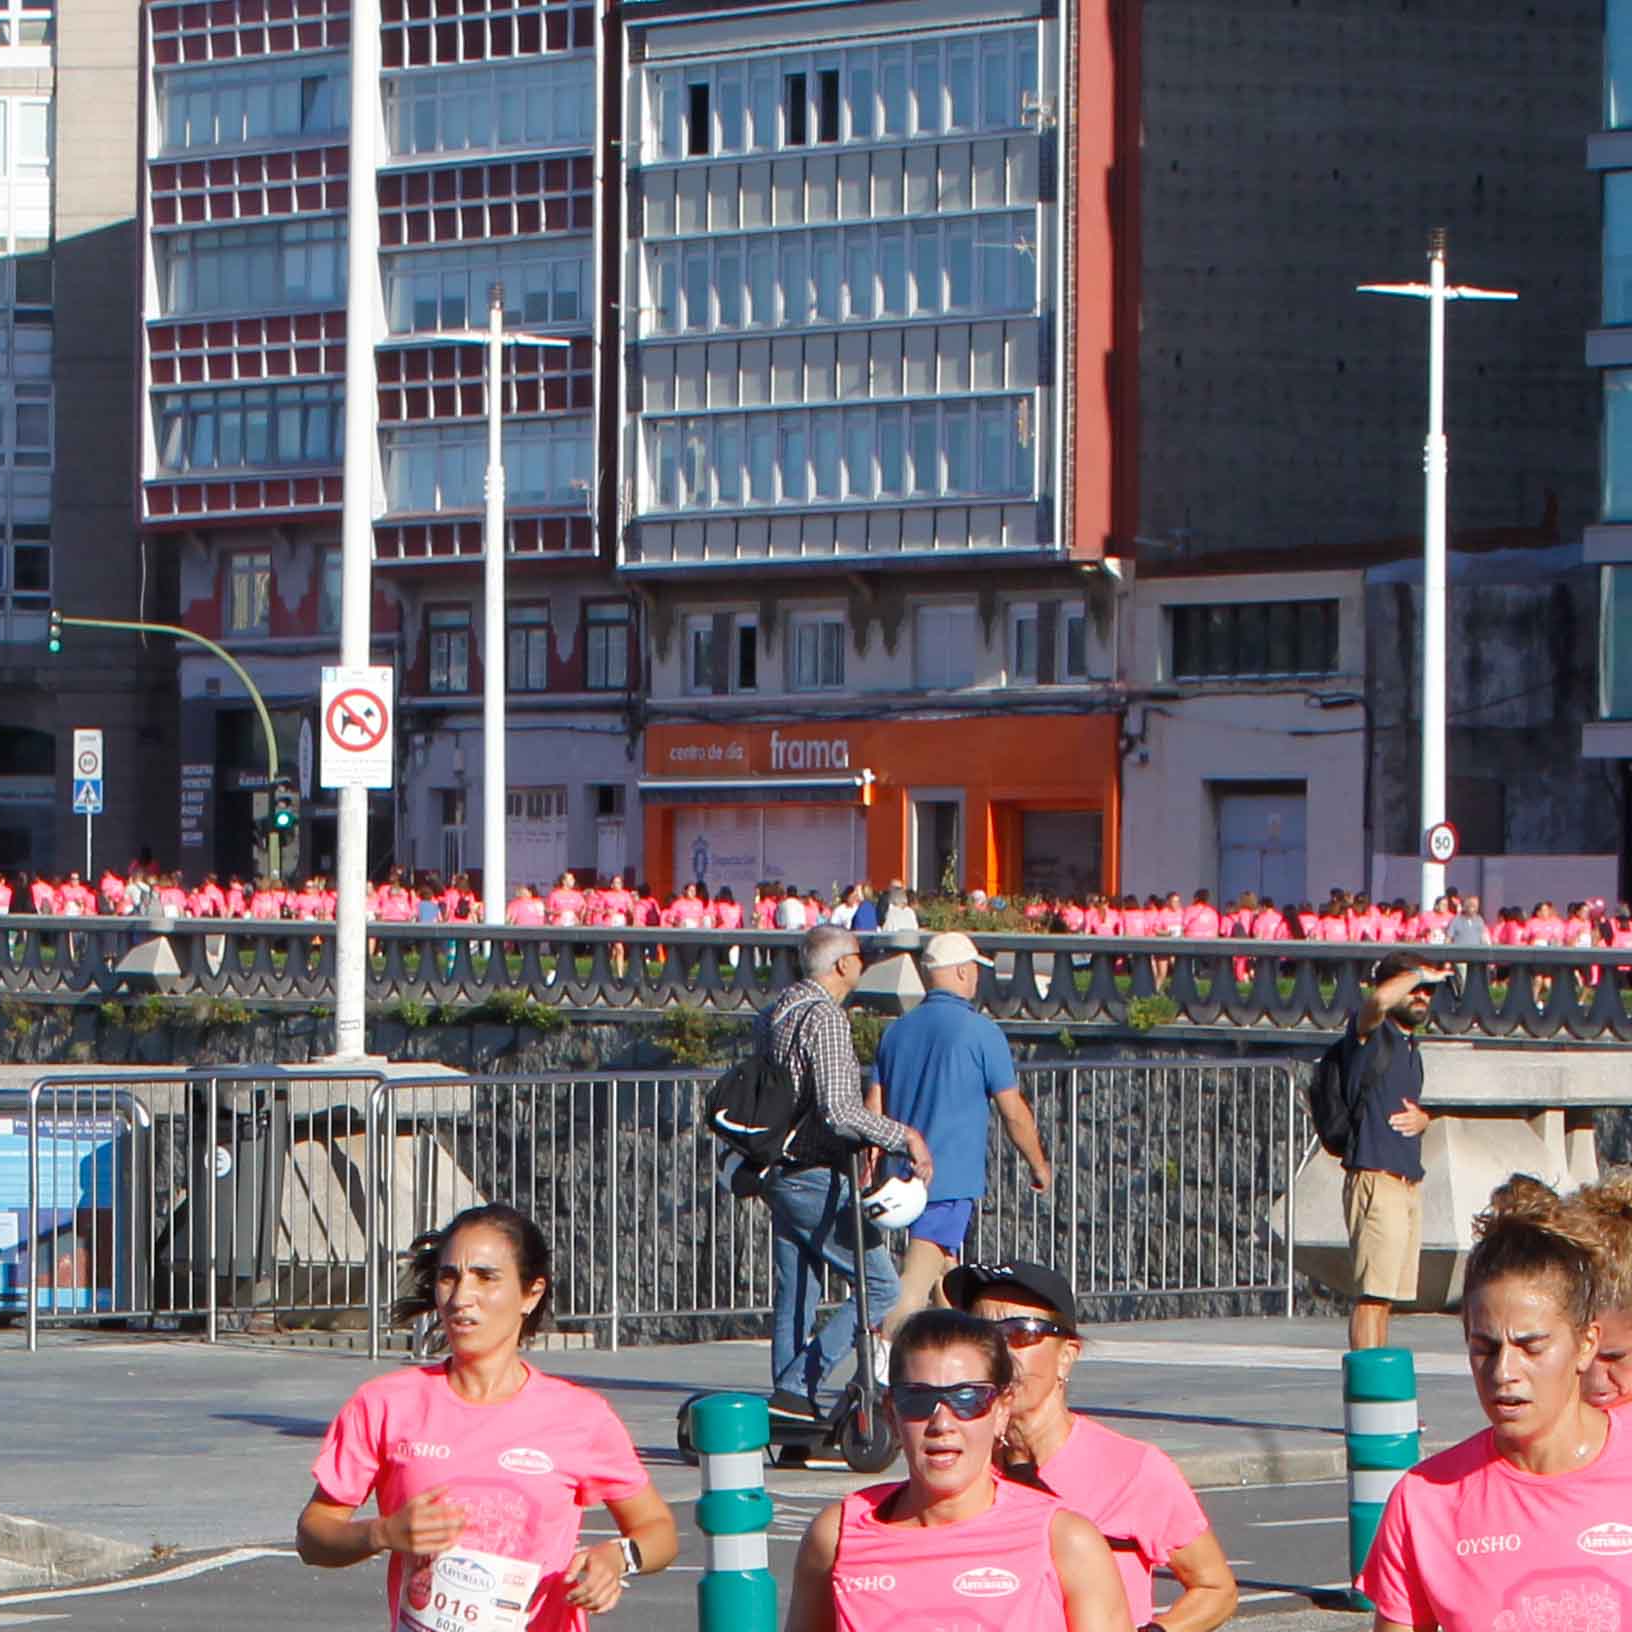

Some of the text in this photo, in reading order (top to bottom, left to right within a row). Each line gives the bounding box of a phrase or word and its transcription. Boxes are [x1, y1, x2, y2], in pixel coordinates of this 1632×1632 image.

[671, 744, 704, 760] centro
[708, 743, 722, 760] de
[770, 730, 849, 768] frama
[1435, 836, 1450, 851] 50
[1456, 1534, 1521, 1556] OYSHO
[434, 1592, 480, 1622] 016
